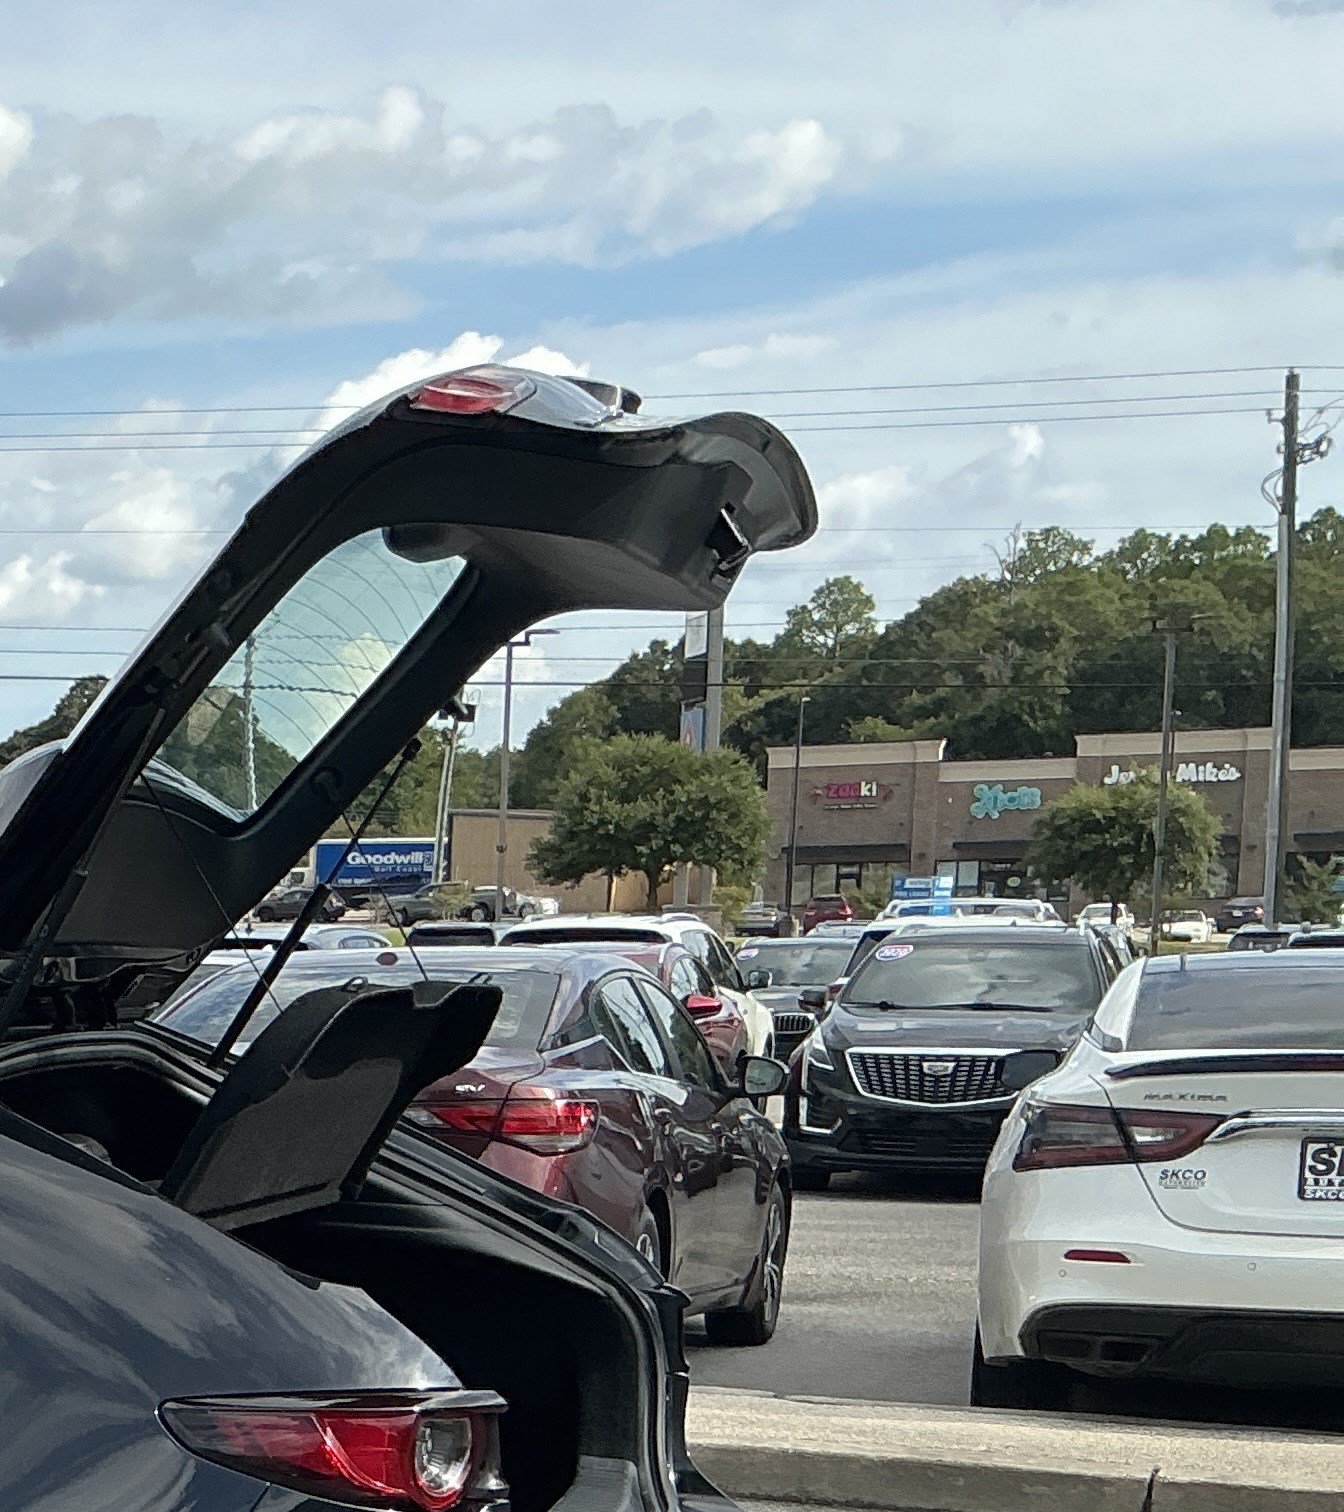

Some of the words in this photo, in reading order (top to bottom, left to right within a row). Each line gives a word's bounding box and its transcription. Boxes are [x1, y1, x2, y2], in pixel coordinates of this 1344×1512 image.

[1176, 762, 1241, 782] Mike's
[347, 851, 423, 865] Goodwill
[1159, 1169, 1207, 1181] SKCO
